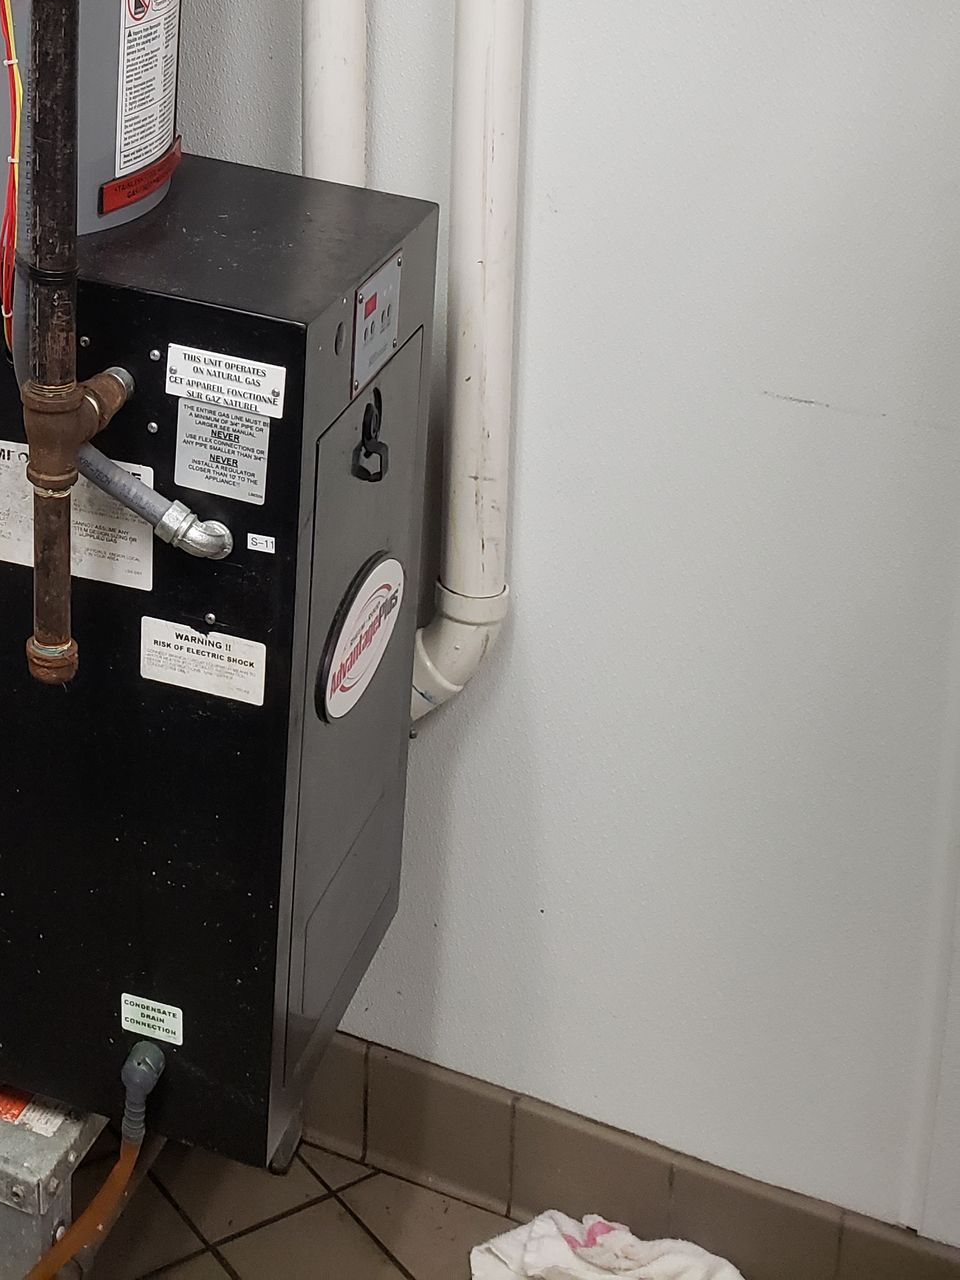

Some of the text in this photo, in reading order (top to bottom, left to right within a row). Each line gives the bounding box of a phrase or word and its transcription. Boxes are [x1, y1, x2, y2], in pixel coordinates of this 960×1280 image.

[183, 352, 267, 377] THIS UNIT OPERATES
[193, 366, 261, 387] ON NATURAL GAS
[169, 376, 278, 406] CET APPAREIL FONCTIONNE
[187, 390, 260, 412] SUR GAZ NATUREL
[194, 413, 219, 423] MINIMUM
[241, 423, 253, 431] PIPE
[196, 407, 216, 416] ENTIRE
[245, 417, 261, 425] MUST
[199, 435, 212, 443] FLEX
[214, 439, 255, 453] CONNECTIONS
[211, 430, 240, 441] NEVER
[209, 445, 235, 455] SMALLER
[237, 451, 252, 459] THAN
[209, 454, 238, 466] NEVER
[188, 464, 211, 474] CLOSER
[213, 470, 228, 478] THAN
[192, 459, 214, 468] INSTALL
[221, 465, 255, 477] REGULATOR
[251, 537, 274, 550] S-11
[175, 632, 223, 650] WARNING
[153, 639, 255, 668] RISK OF ELECTRIC SHOCK
[124, 1000, 177, 1018] CONDENSATE
[141, 1012, 164, 1023] DRAIN
[124, 1017, 176, 1035] CONNECTION
